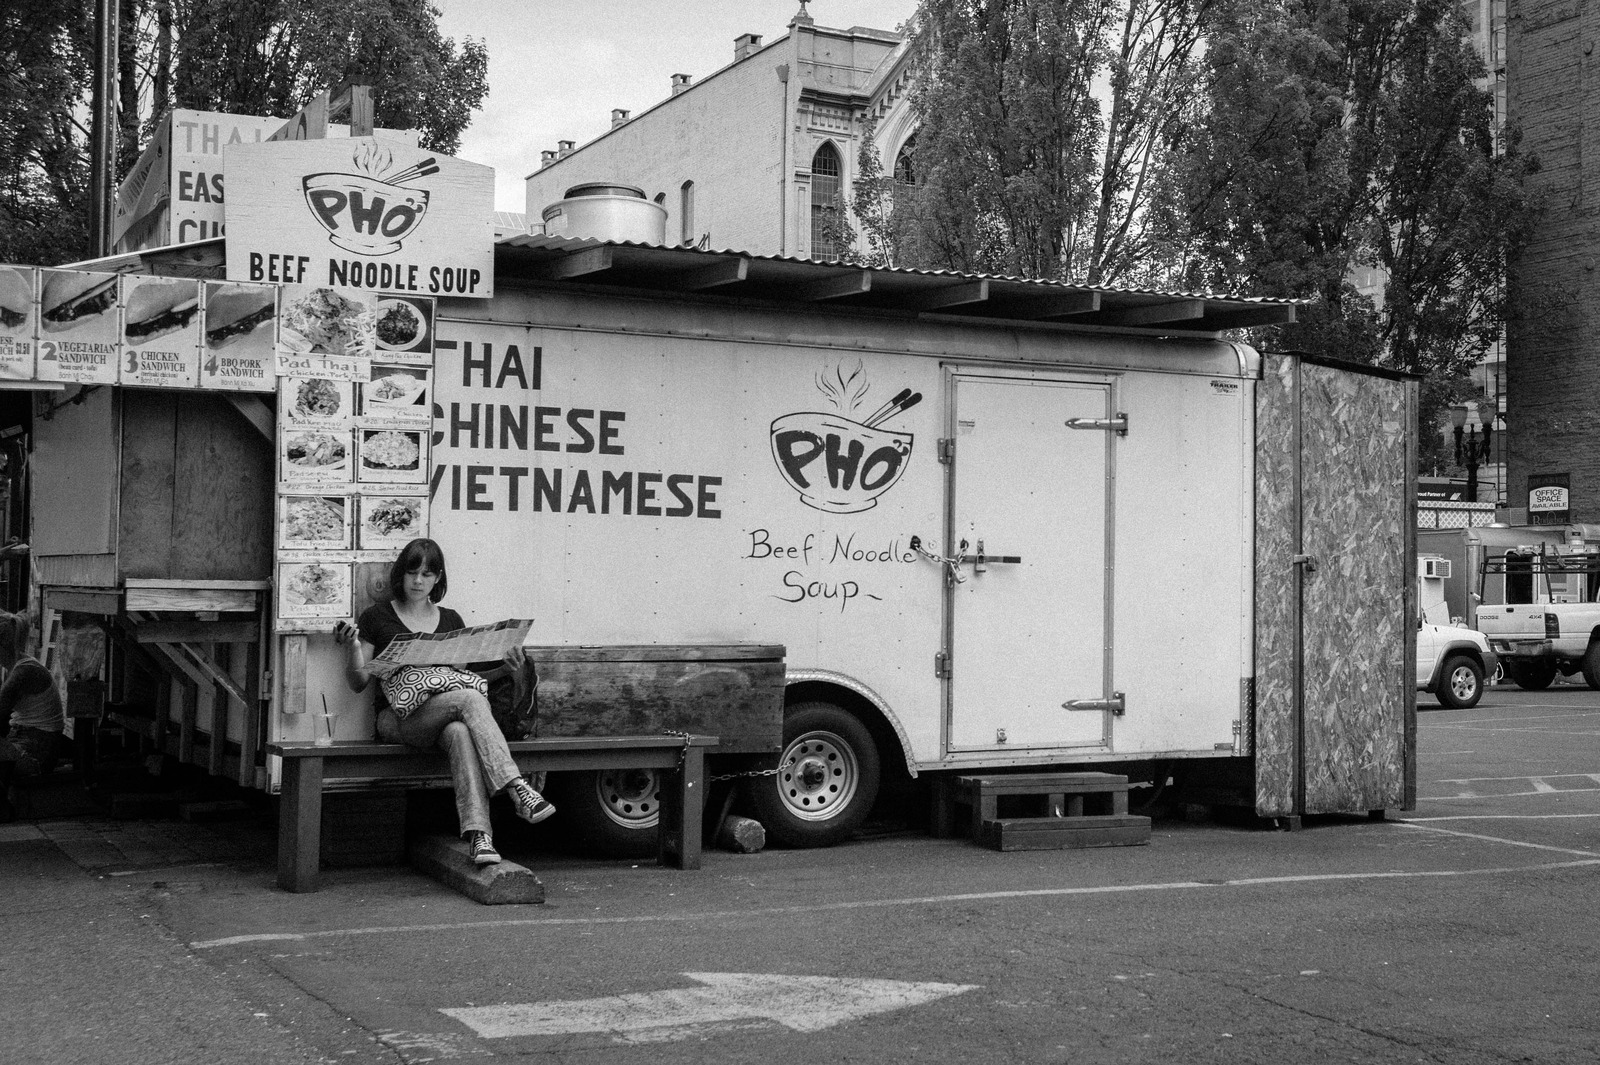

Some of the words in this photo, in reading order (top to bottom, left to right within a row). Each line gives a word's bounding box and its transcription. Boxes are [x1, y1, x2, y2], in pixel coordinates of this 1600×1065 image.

[249, 252, 310, 284] BEEF
[329, 259, 419, 291] NOODLE
[429, 266, 481, 294] SOUP
[41, 341, 58, 361] 2
[58, 341, 116, 354] VEGETARIAN
[59, 353, 107, 365] SANDWICH
[124, 350, 139, 374] 3
[141, 351, 180, 362] CHICKEN
[221, 358, 238, 369] BBQ
[239, 359, 262, 369] PORK
[141, 361, 186, 372] SANDWICH
[203, 355, 220, 377] 4
[277, 356, 311, 369] Pad
[318, 359, 358, 372] Thai
[220, 368, 264, 379] SANDWICH
[1535, 488, 1563, 497] OFFICE
[747, 529, 815, 565] Beef
[830, 532, 917, 564] Noodle
[771, 570, 859, 614] Soup
